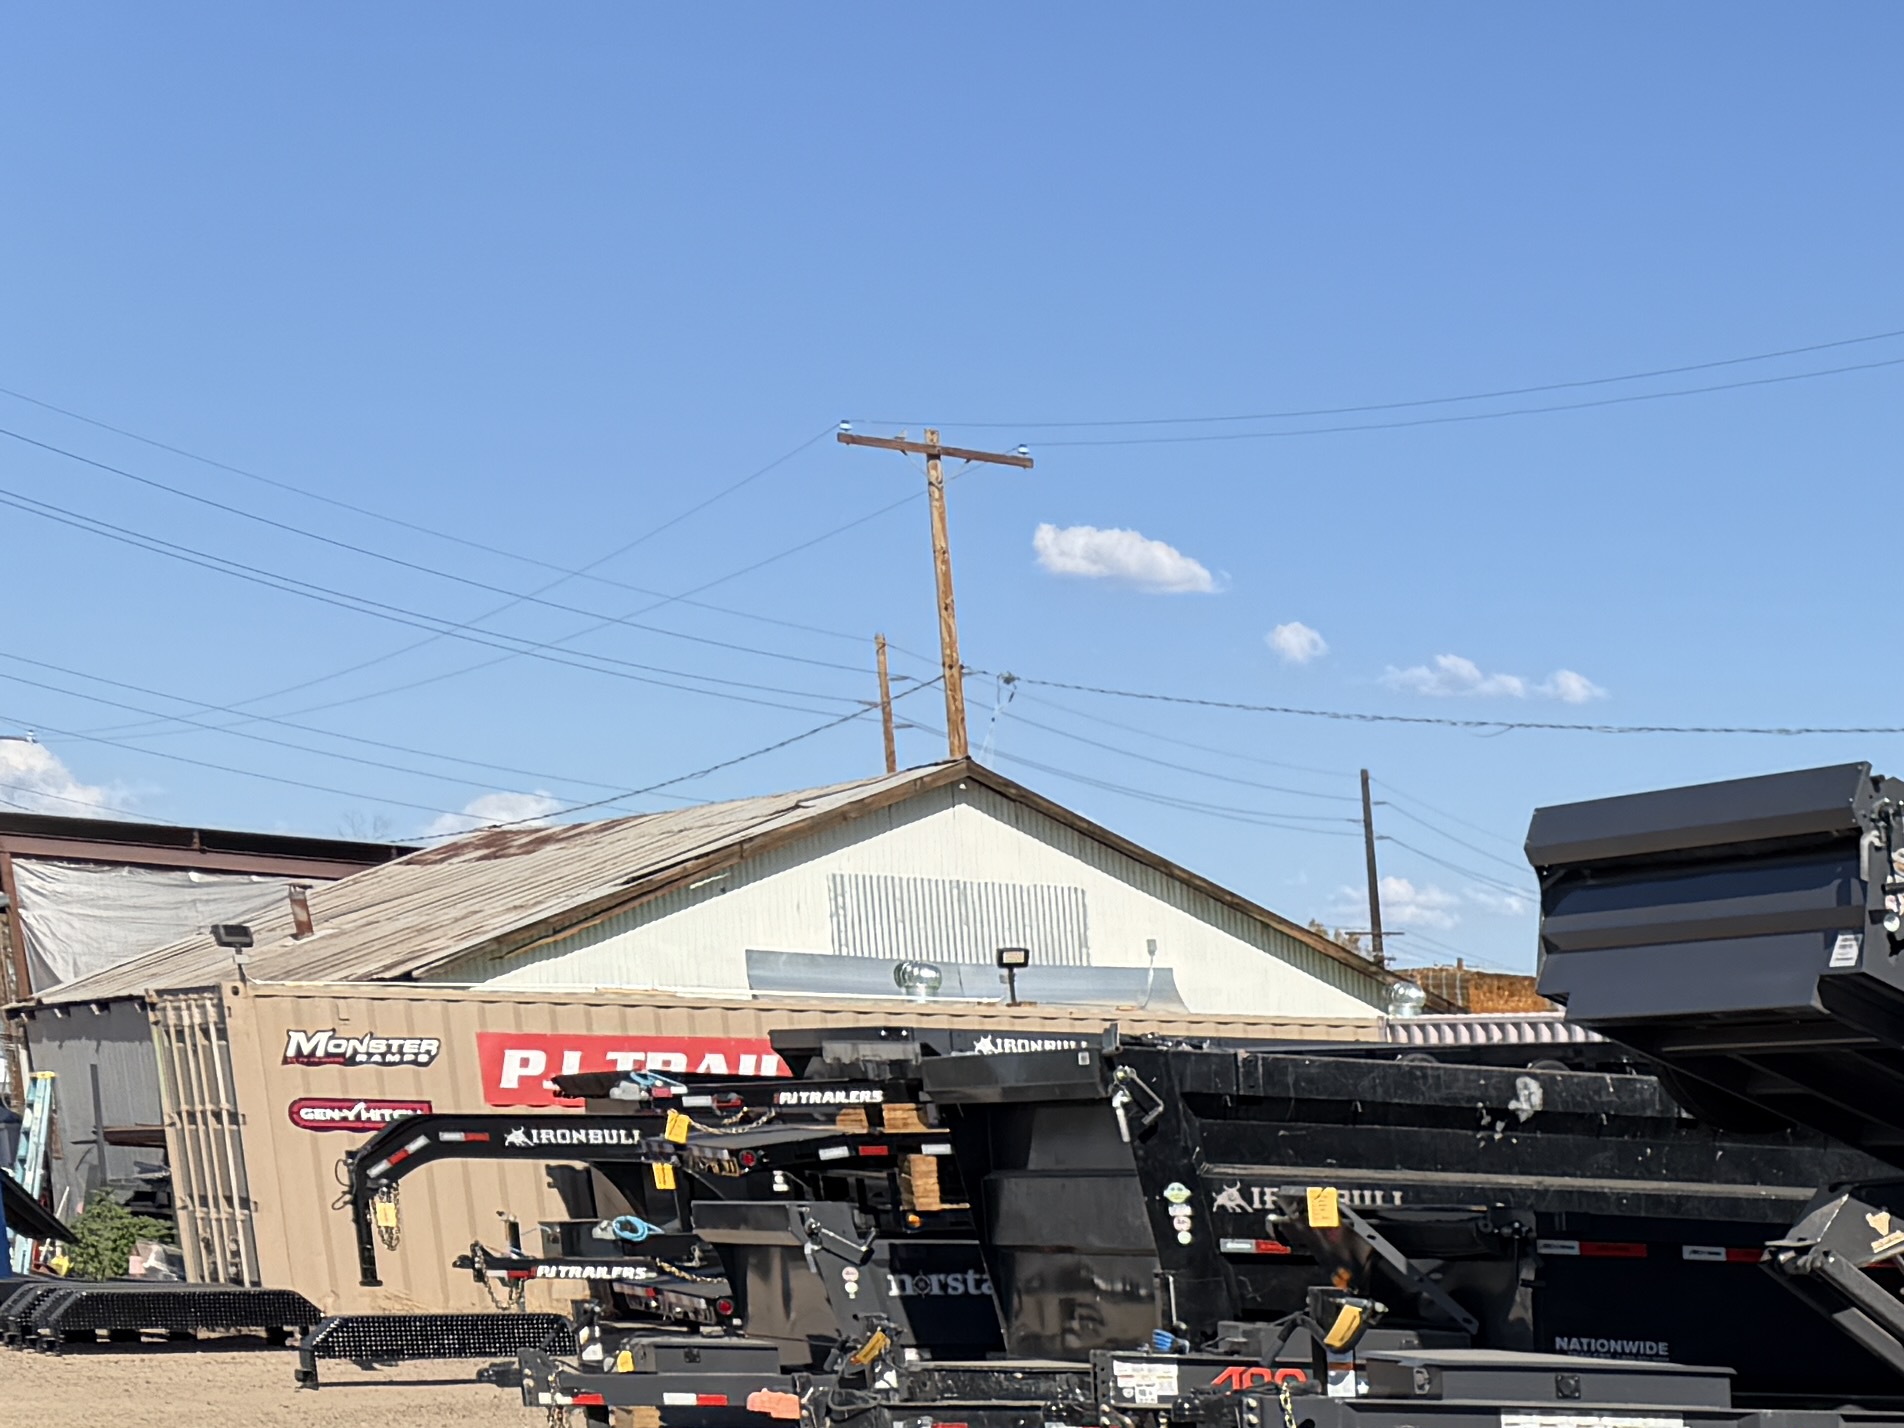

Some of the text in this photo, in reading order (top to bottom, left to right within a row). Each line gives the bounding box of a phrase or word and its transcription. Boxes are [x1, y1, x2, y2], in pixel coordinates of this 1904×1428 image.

[355, 1053, 430, 1063] RAMPS
[800, 1090, 883, 1104] TRAILERS
[557, 1265, 646, 1279] TRAILERS
[1555, 1336, 1669, 1355] NATIONWIDE
